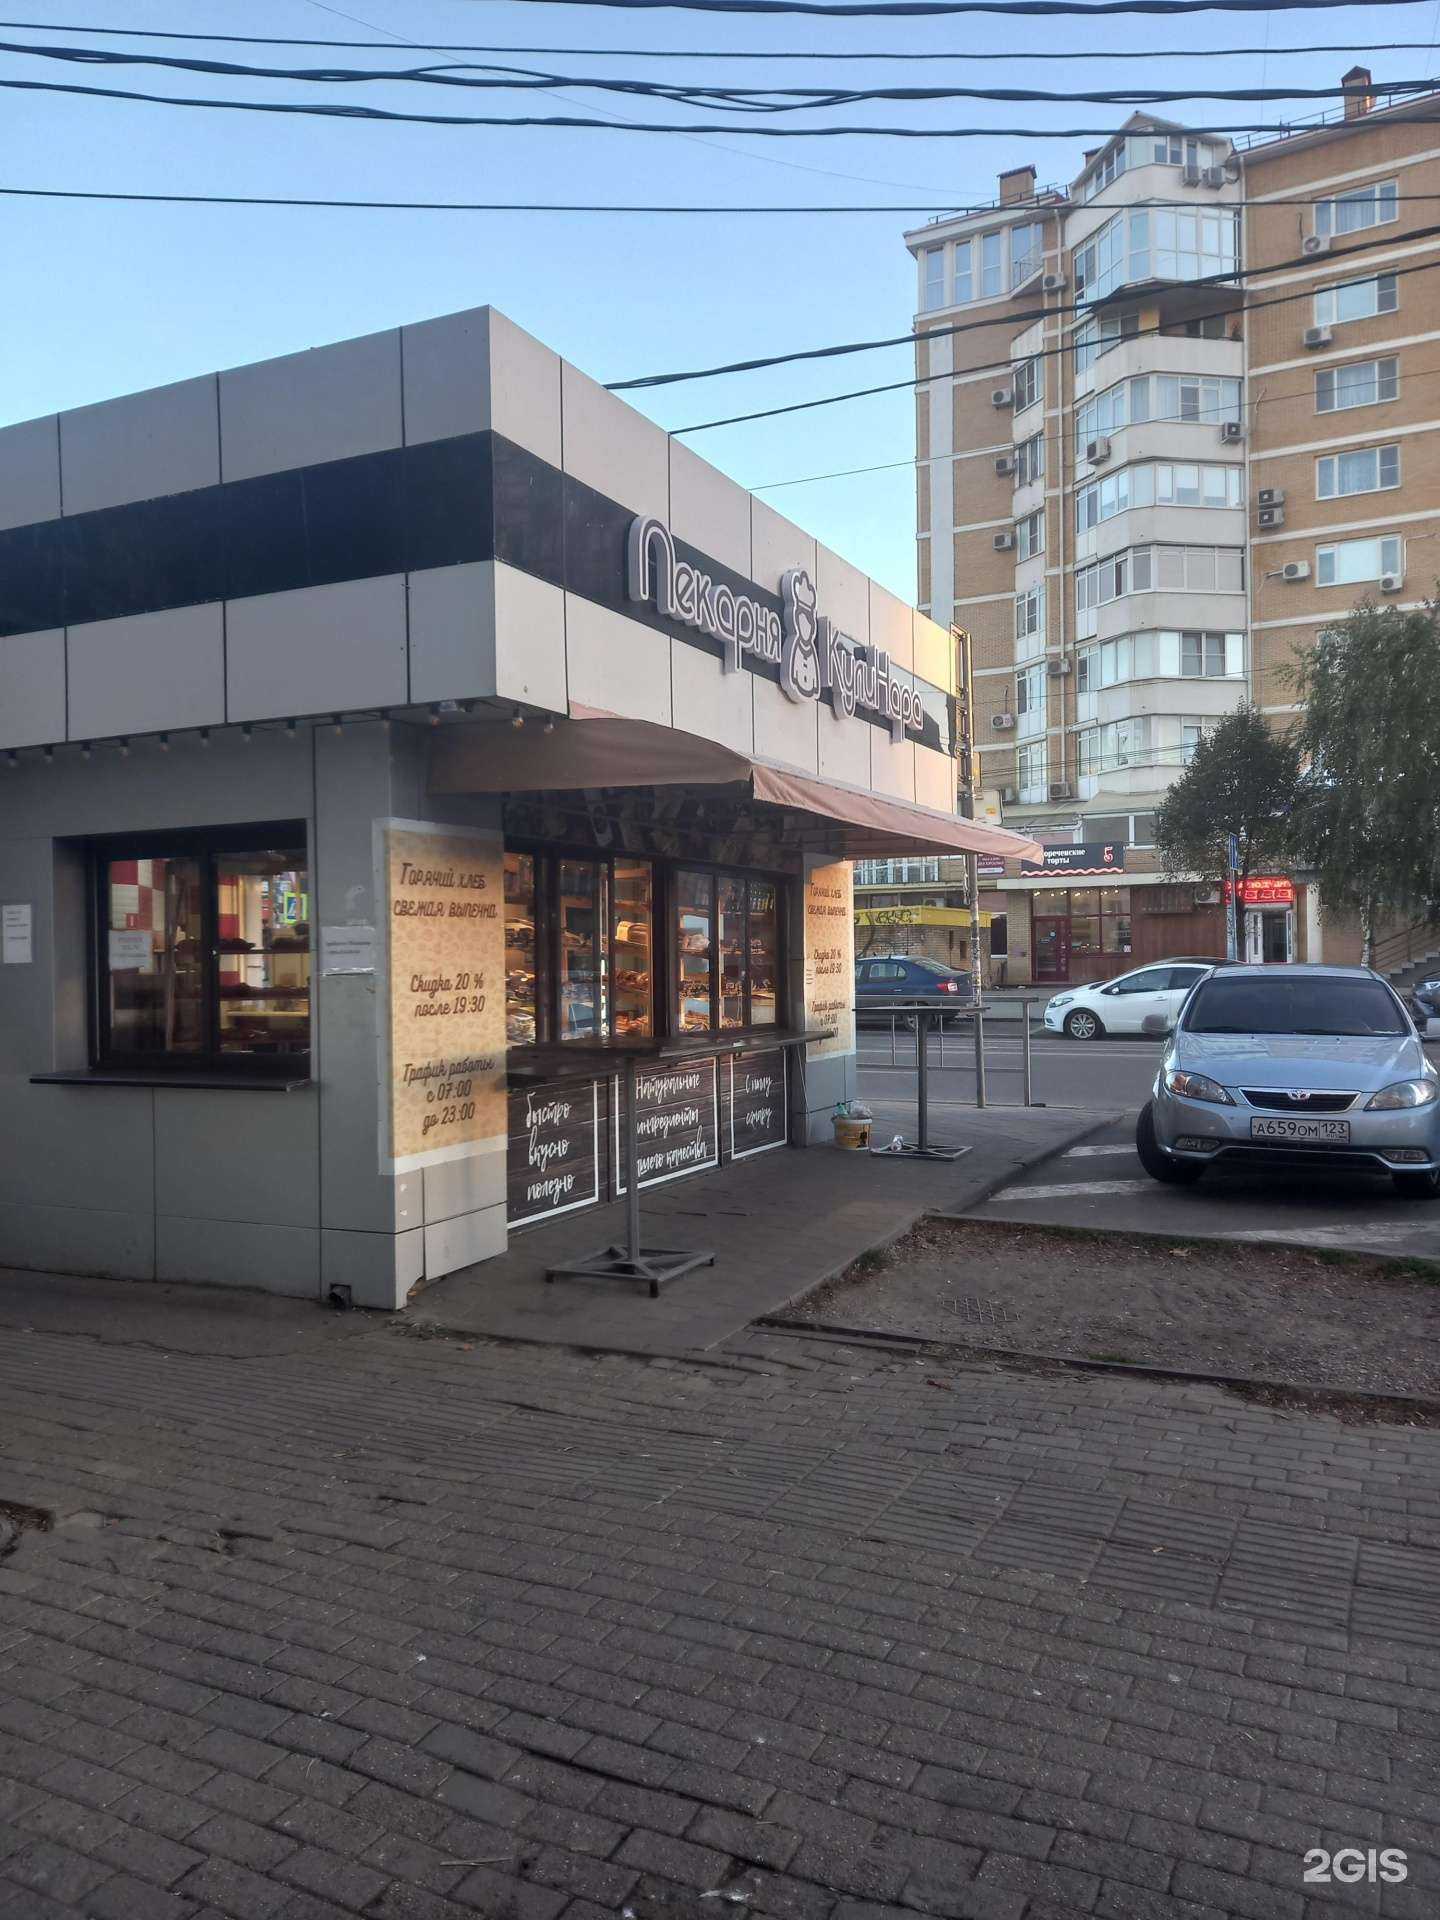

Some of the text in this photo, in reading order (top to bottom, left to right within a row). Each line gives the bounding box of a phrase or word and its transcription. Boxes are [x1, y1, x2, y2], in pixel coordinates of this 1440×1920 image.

[630, 514, 782, 674] Пекарня
[1043, 849, 1086, 858] ореченские
[1047, 857, 1070, 866] торты
[410, 972, 485, 999] Скидка 20 %
[414, 995, 486, 1018] после 19:30
[403, 1057, 495, 1087] График работы
[426, 1079, 473, 1103] с 07:00
[635, 1073, 700, 1104] Натуральные
[422, 1102, 476, 1135] до 23:00
[526, 1091, 572, 1128] быстро
[1256, 1120, 1346, 1137] А659ОМ 123
[528, 1124, 570, 1173] вкусно
[527, 1174, 576, 1205] полезно
